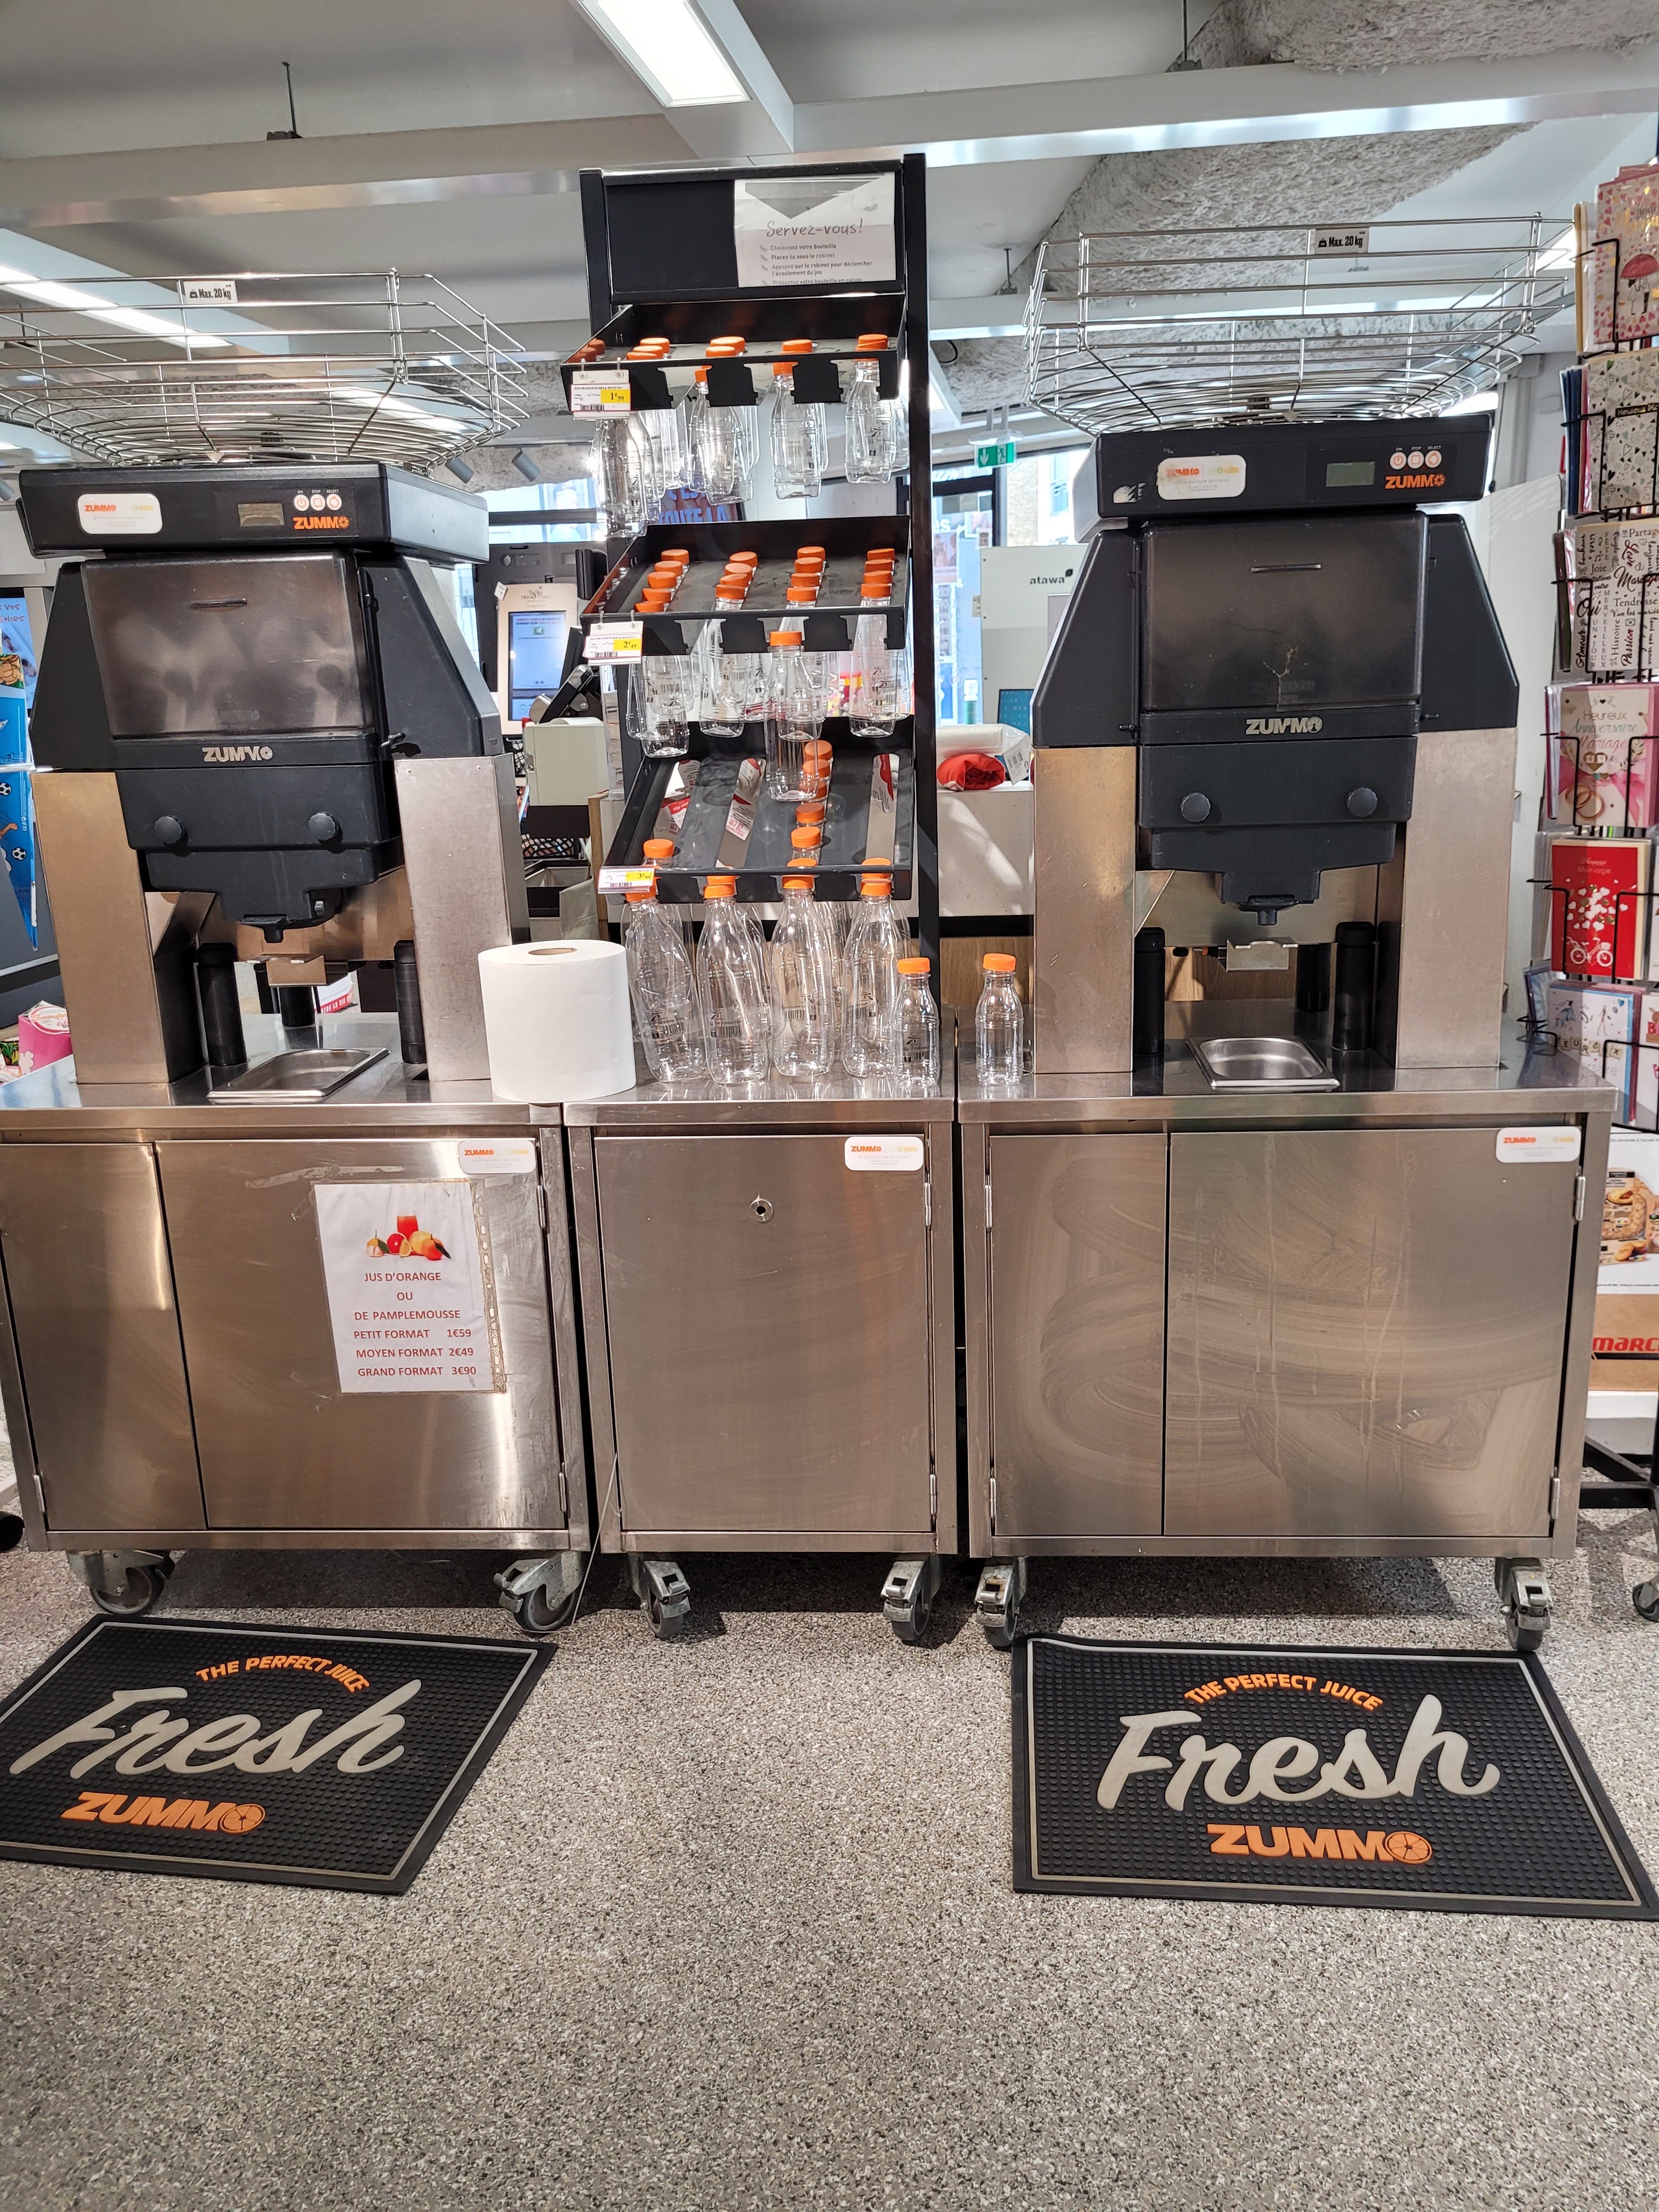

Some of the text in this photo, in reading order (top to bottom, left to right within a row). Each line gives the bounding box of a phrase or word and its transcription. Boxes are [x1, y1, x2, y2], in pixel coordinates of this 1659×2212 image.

[766, 218, 862, 237] Servez-vous!
[1329, 235, 1363, 248] Max. 20 kg
[199, 288, 232, 300] Max. 20 kg
[1385, 473, 1446, 489] ZUMMO
[293, 516, 350, 529] ZUMMO
[1030, 576, 1064, 585] atawa
[1613, 566, 1658, 592] Marage
[1613, 597, 1658, 607] Tendrsse
[1583, 709, 1627, 721] Heureux
[1246, 716, 1323, 735] ZUMMO
[202, 746, 273, 762] ZUMMO
[364, 1272, 442, 1281] JUS D'ORANGE
[397, 1292, 413, 1300] OU
[354, 1310, 460, 1320] DE PAMPLEMOUSSE
[354, 1329, 471, 1339] PETIT FORMAT 1€59
[356, 1347, 473, 1358] MOYEN FORMAT 2€49
[358, 1367, 476, 1376] GRAND FORMAT 3€90
[196, 1656, 370, 1692] THE PERFECT JUICE
[1184, 1674, 1383, 1711] THE PERFECT JUICE
[9, 1679, 421, 1779] Fresh
[1097, 1694, 1500, 1812] Fresh
[60, 1792, 266, 1833] ZUMMO
[1207, 1824, 1432, 1864] ZUMMO
